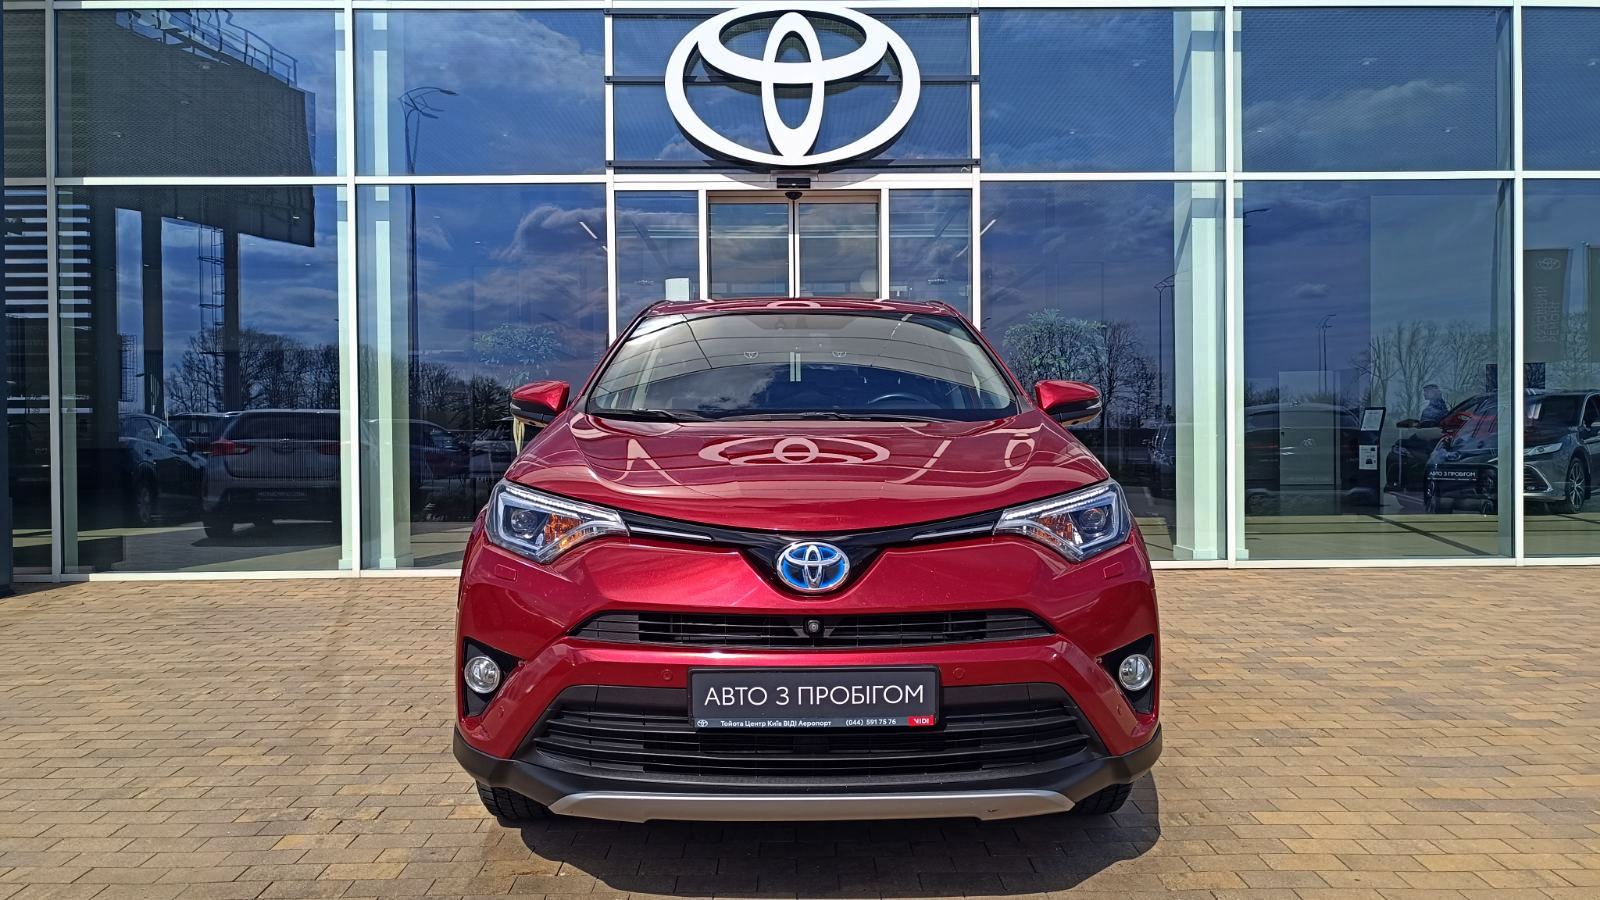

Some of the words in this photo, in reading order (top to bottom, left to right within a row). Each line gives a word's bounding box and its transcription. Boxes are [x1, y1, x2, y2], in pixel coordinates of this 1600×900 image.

[704, 687, 768, 706] АВТО
[776, 686, 790, 706] З
[798, 684, 924, 705] ПРОБІГОМ
[744, 720, 767, 728] Центр
[767, 719, 782, 727] Київ
[798, 719, 832, 727] Аеропорт
